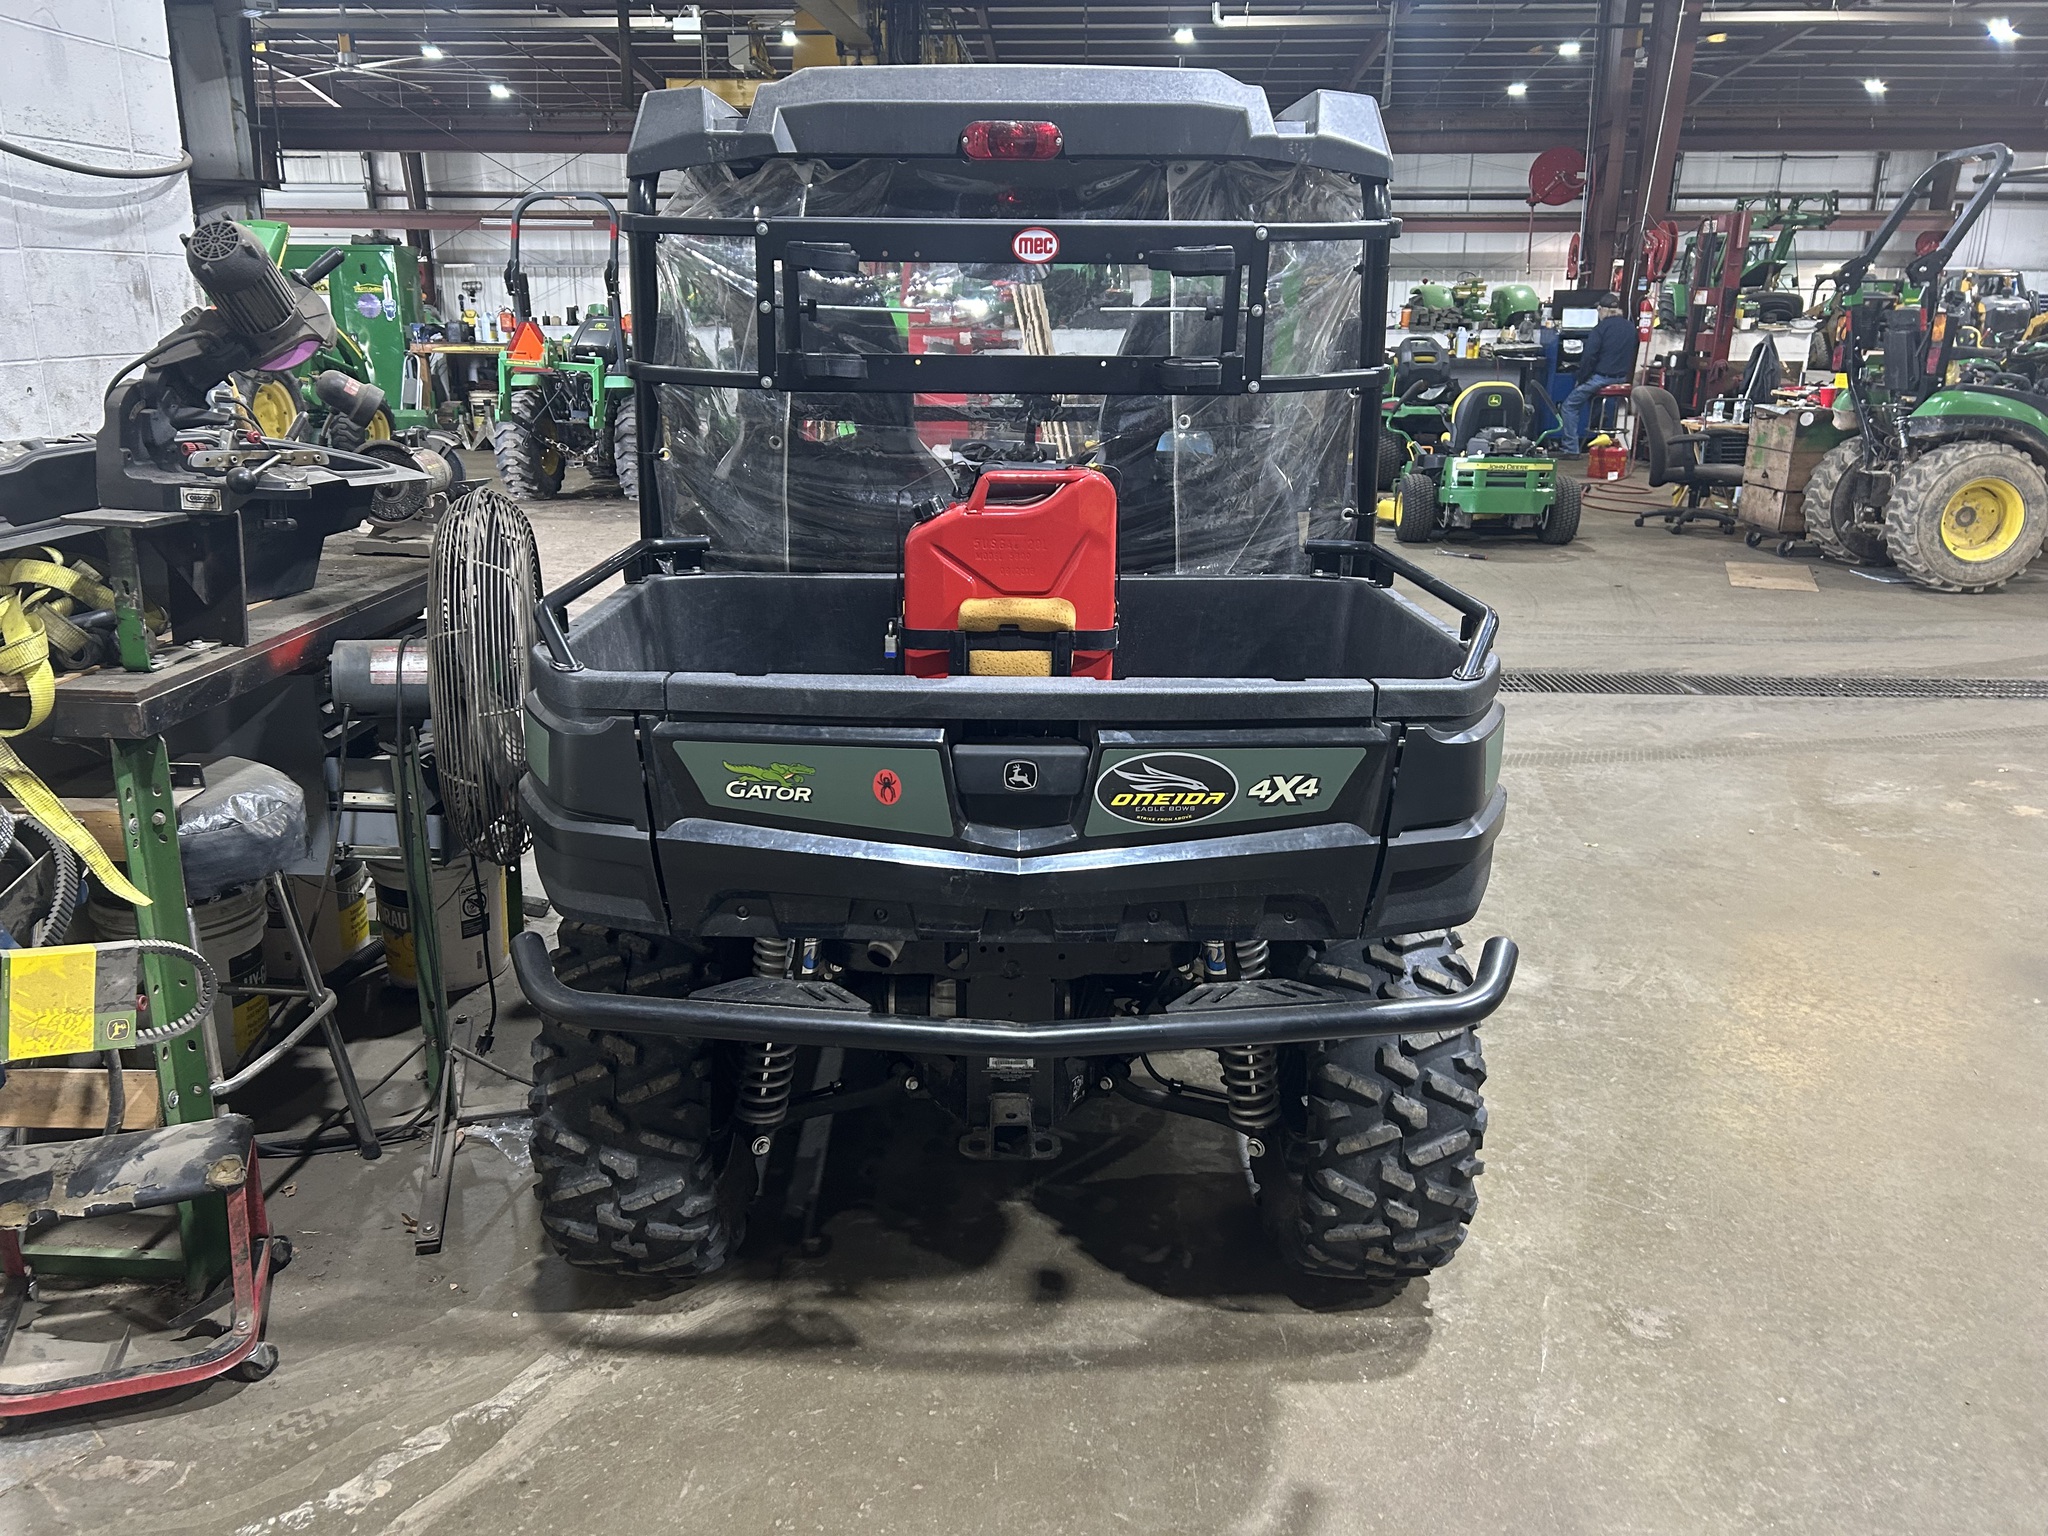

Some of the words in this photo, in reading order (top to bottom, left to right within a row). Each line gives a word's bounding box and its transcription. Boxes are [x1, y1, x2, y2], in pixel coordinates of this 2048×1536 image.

[725, 780, 812, 802] GATOR
[1110, 791, 1226, 806] ONEIDA
[1247, 775, 1320, 804] 4X4
